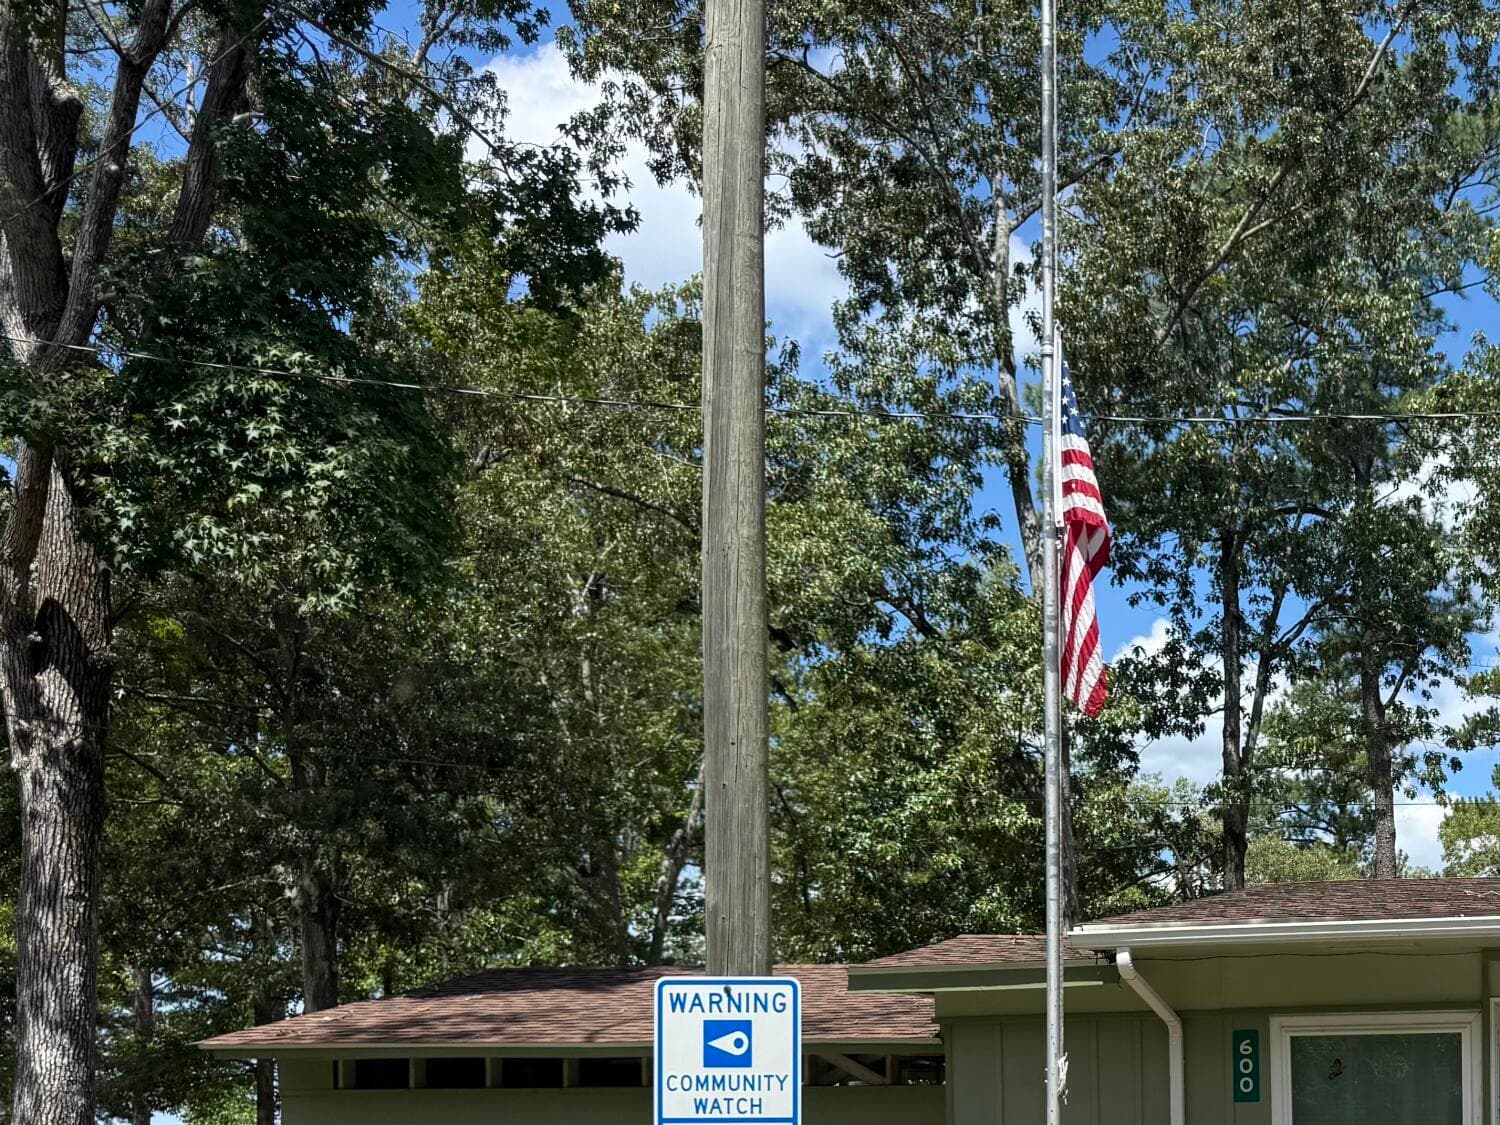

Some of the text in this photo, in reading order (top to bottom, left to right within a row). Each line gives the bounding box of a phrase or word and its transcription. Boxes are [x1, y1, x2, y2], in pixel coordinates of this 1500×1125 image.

[669, 992, 787, 1013] WARNING
[1239, 1039, 1254, 1093] 600
[666, 1075, 788, 1092] COMMUNITY
[694, 1098, 762, 1114] WATCH
